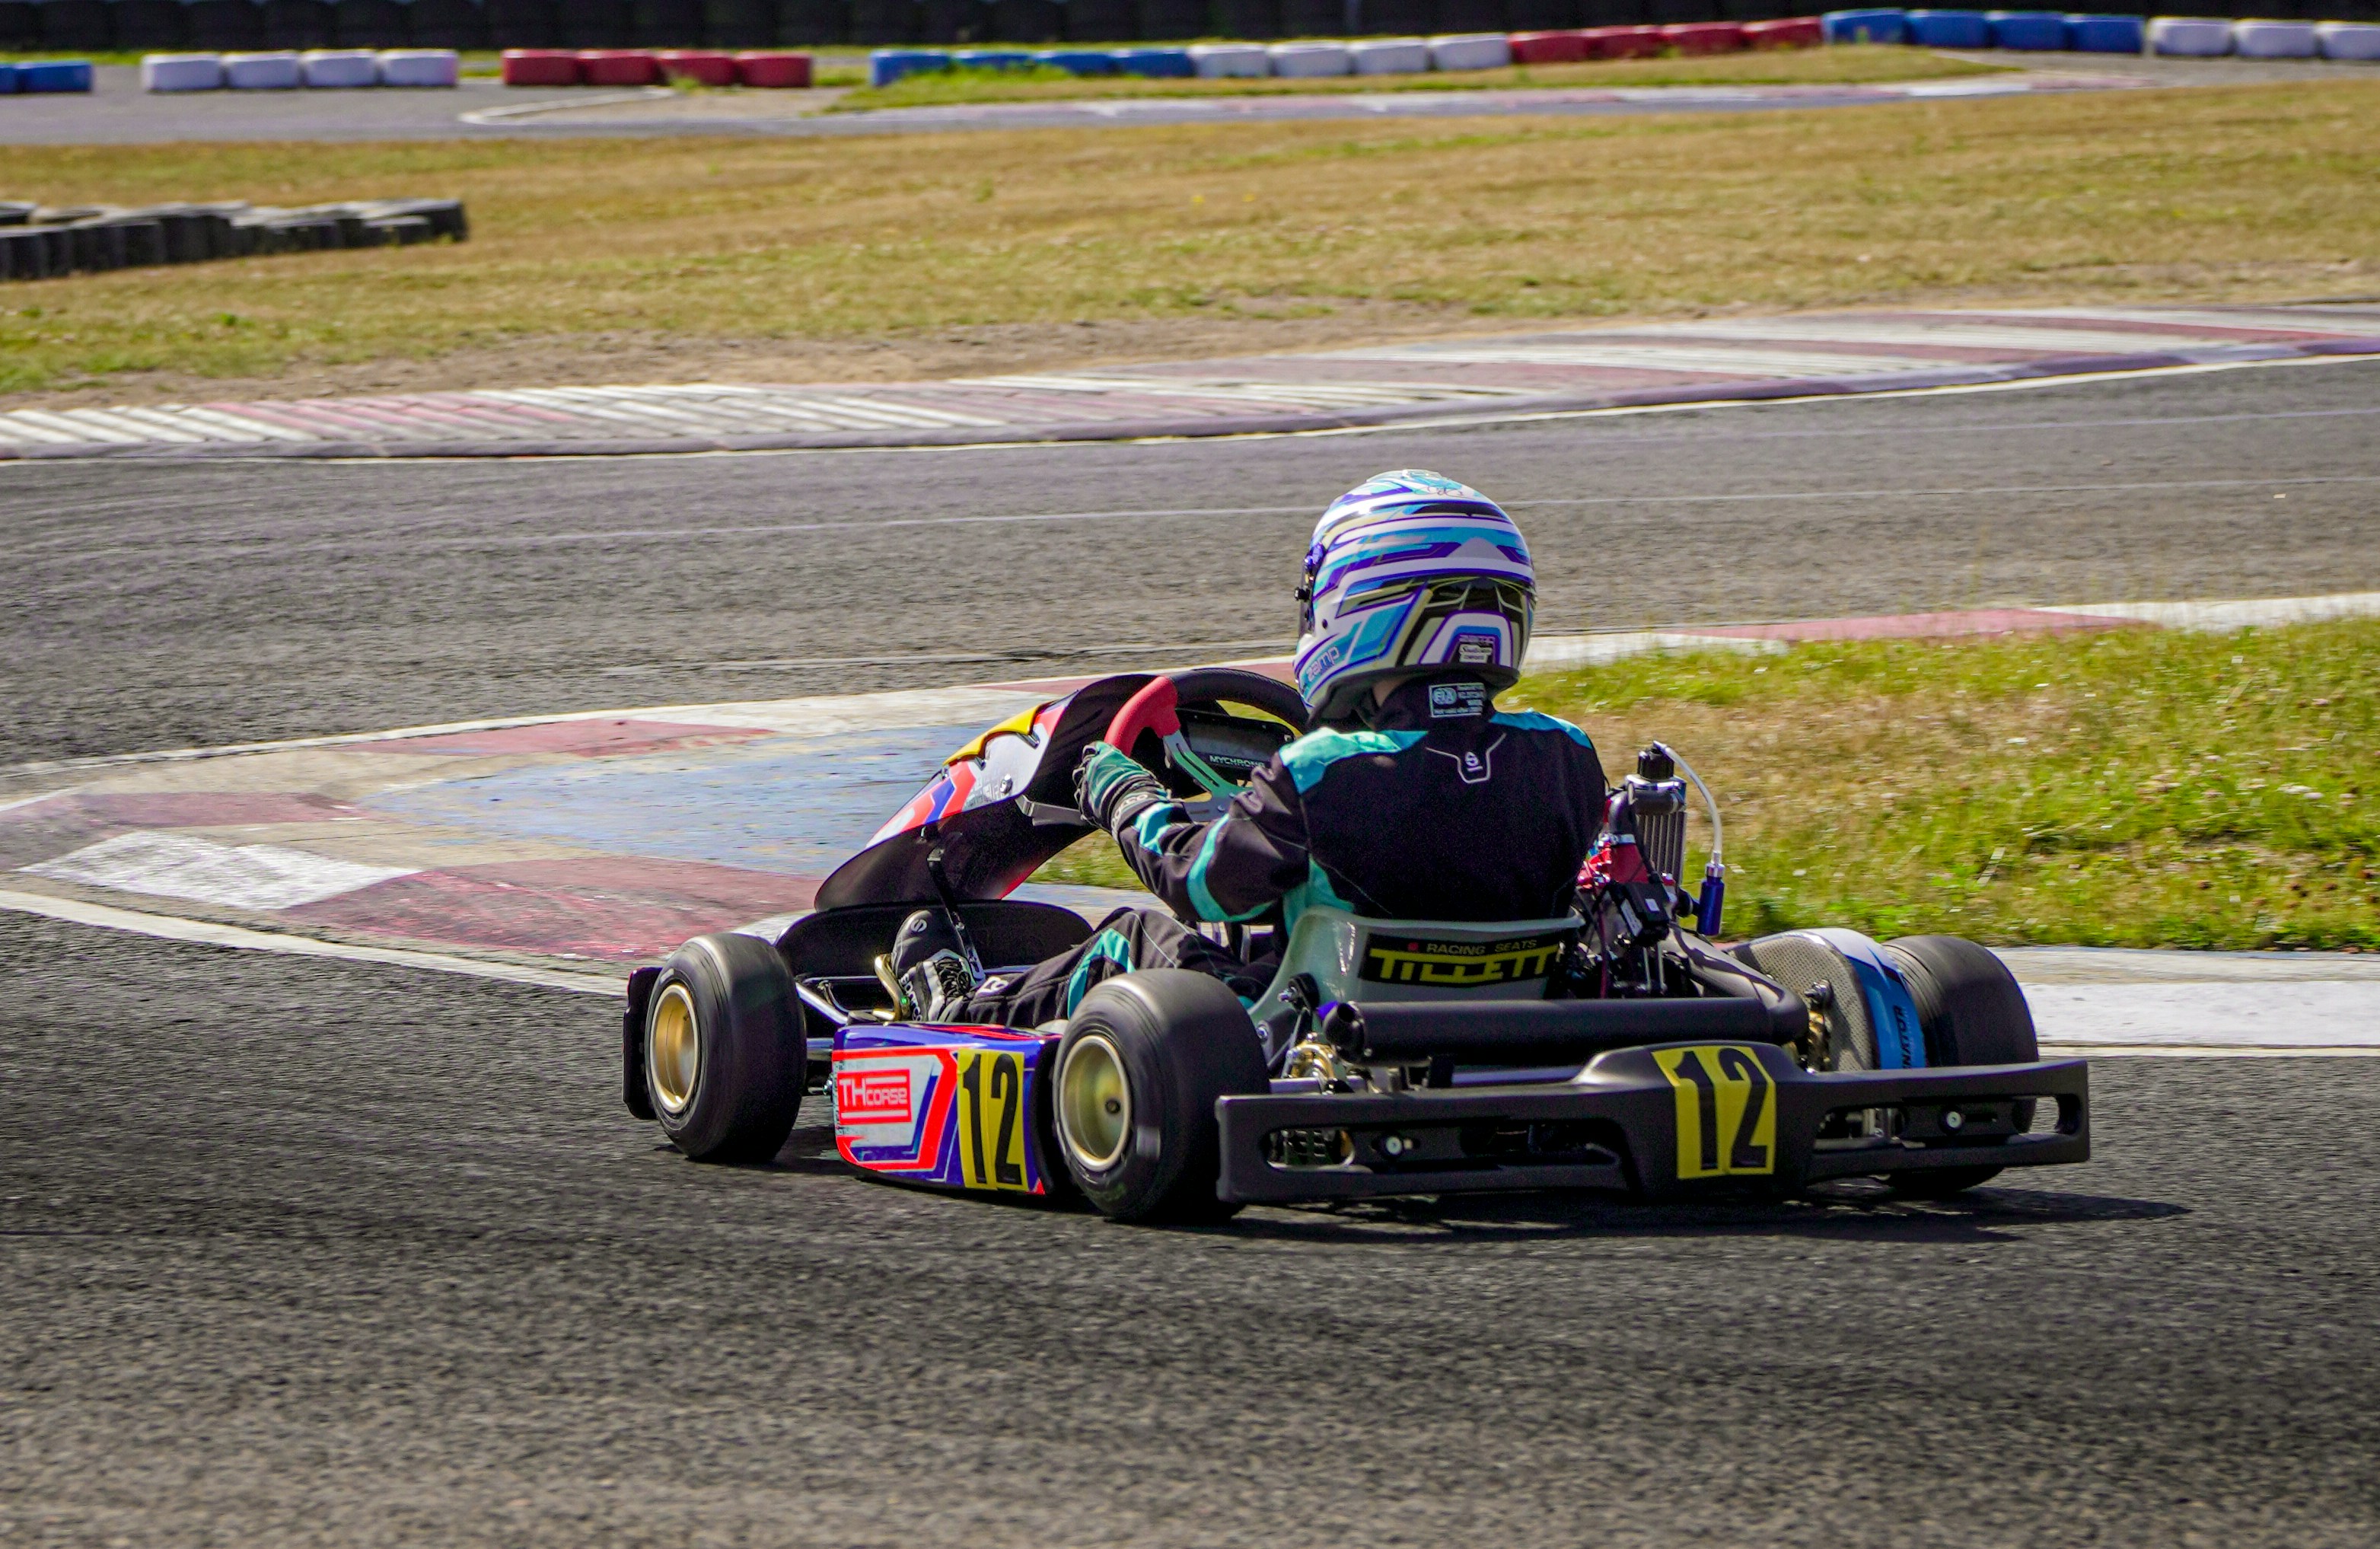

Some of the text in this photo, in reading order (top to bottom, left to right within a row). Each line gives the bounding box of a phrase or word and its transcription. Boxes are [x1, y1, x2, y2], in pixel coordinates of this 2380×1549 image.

[1305, 646, 1340, 681] zamp
[1369, 943, 1562, 984] TILLETT
[1426, 939, 1537, 955] RACING SEATS
[963, 1053, 1024, 1185] 12
[1673, 1047, 1768, 1171] 12
